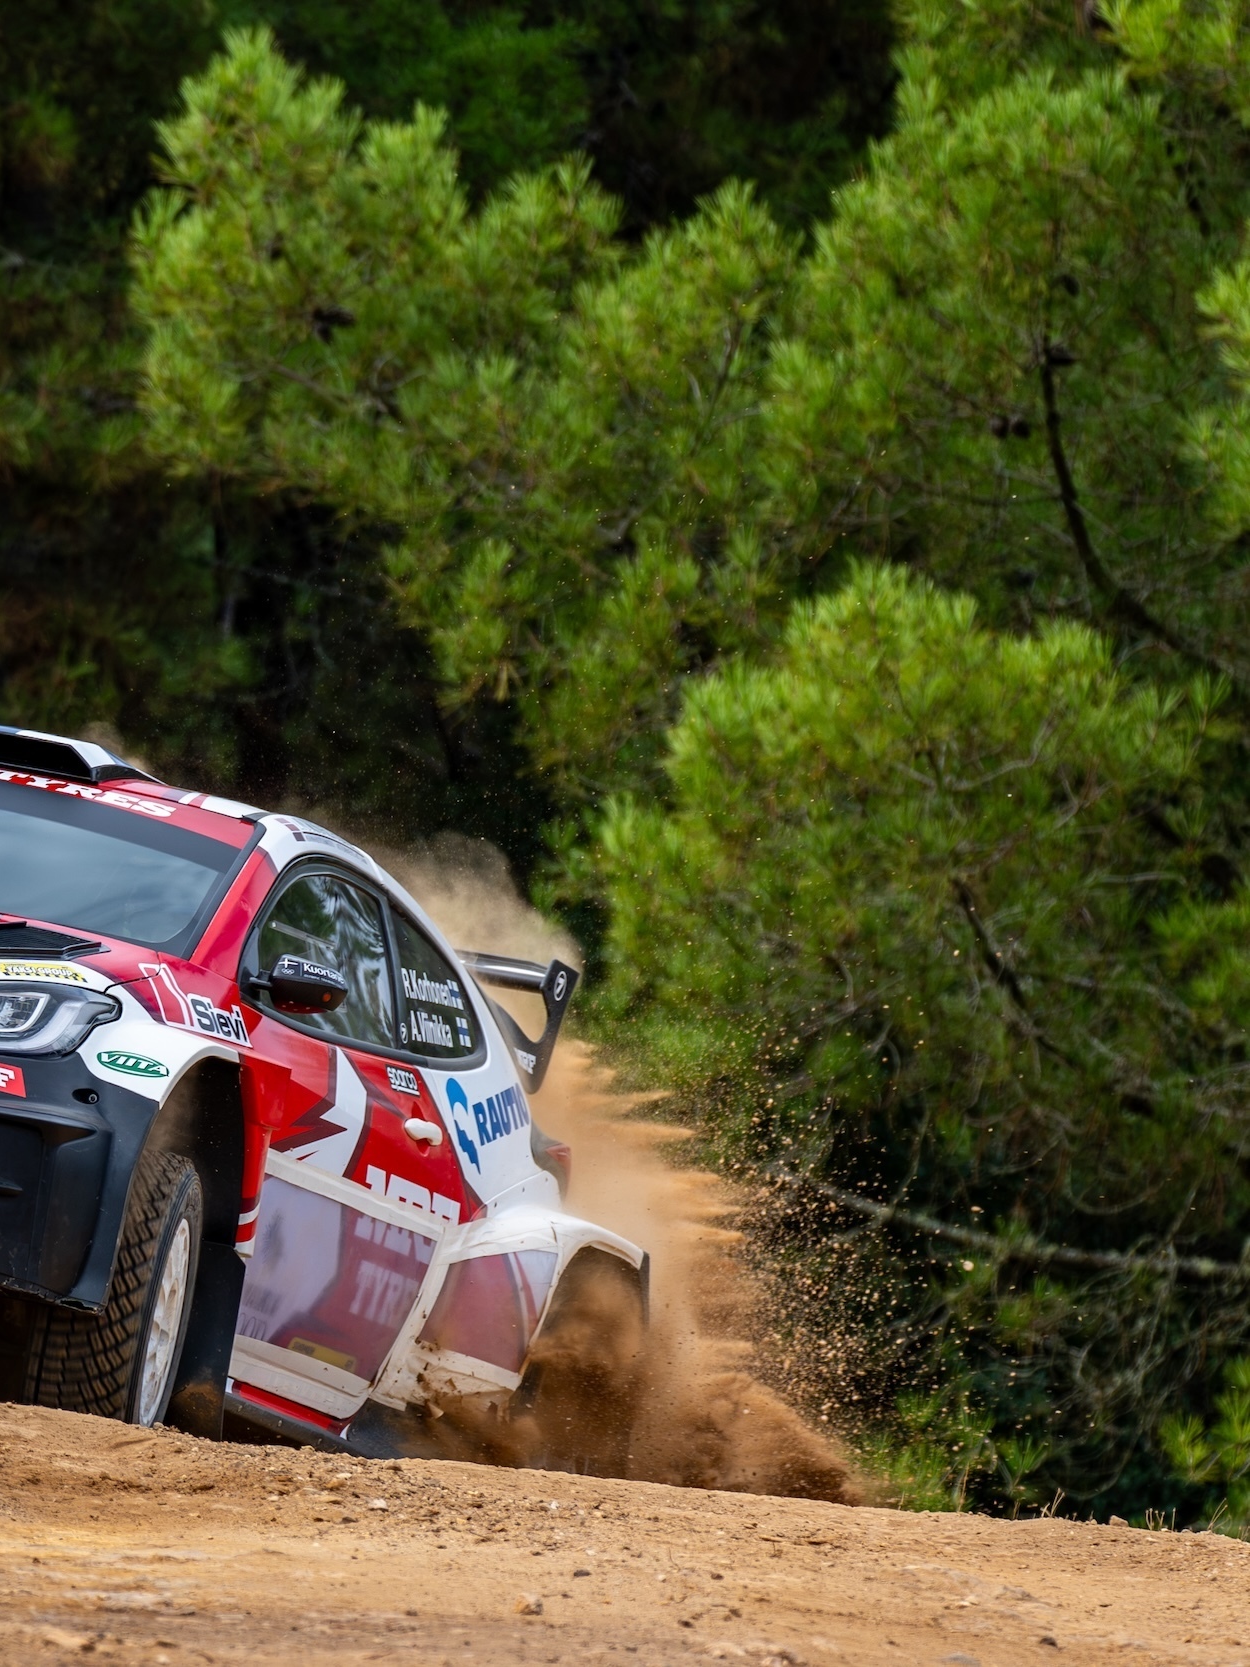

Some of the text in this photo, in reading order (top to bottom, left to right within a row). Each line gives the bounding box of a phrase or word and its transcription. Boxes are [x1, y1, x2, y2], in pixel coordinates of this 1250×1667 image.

[6, 965, 37, 974] TAKSI
[37, 967, 75, 977] GROUP
[190, 998, 248, 1043] Sievi
[100, 1052, 168, 1076] VIITA
[387, 1066, 418, 1092] sparco
